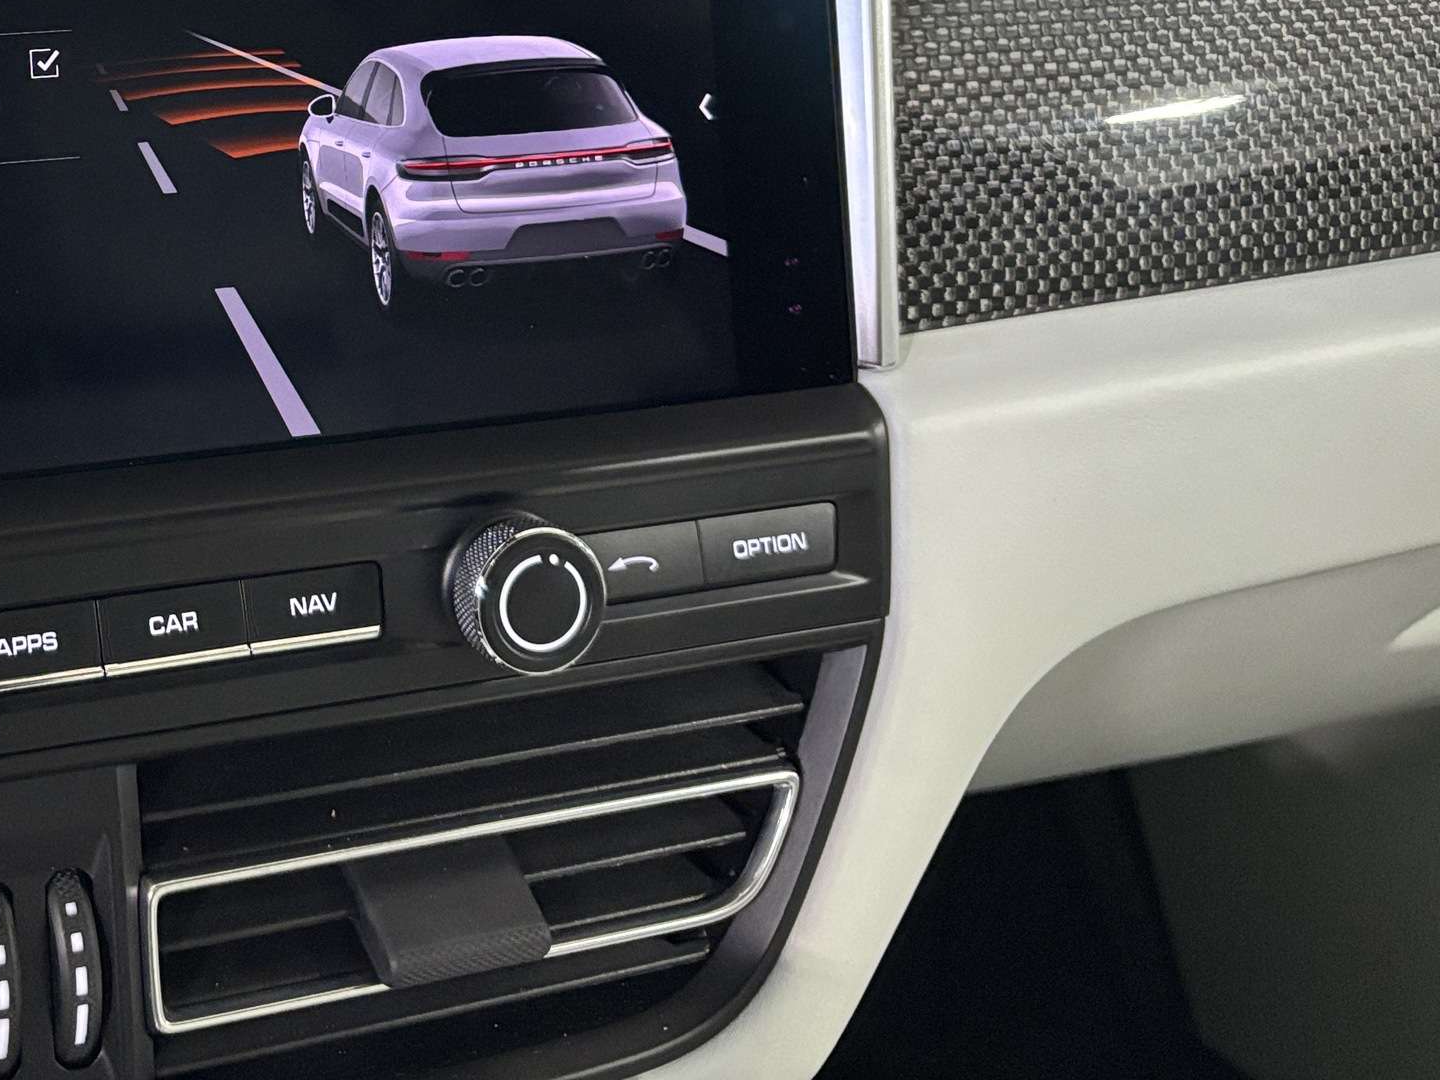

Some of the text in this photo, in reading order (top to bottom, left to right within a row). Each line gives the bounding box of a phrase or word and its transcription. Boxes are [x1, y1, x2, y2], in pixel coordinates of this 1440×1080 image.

[515, 155, 605, 168] PORSCHE
[732, 531, 808, 560] OPTION
[289, 591, 337, 617] NAV
[148, 611, 199, 637] CAR
